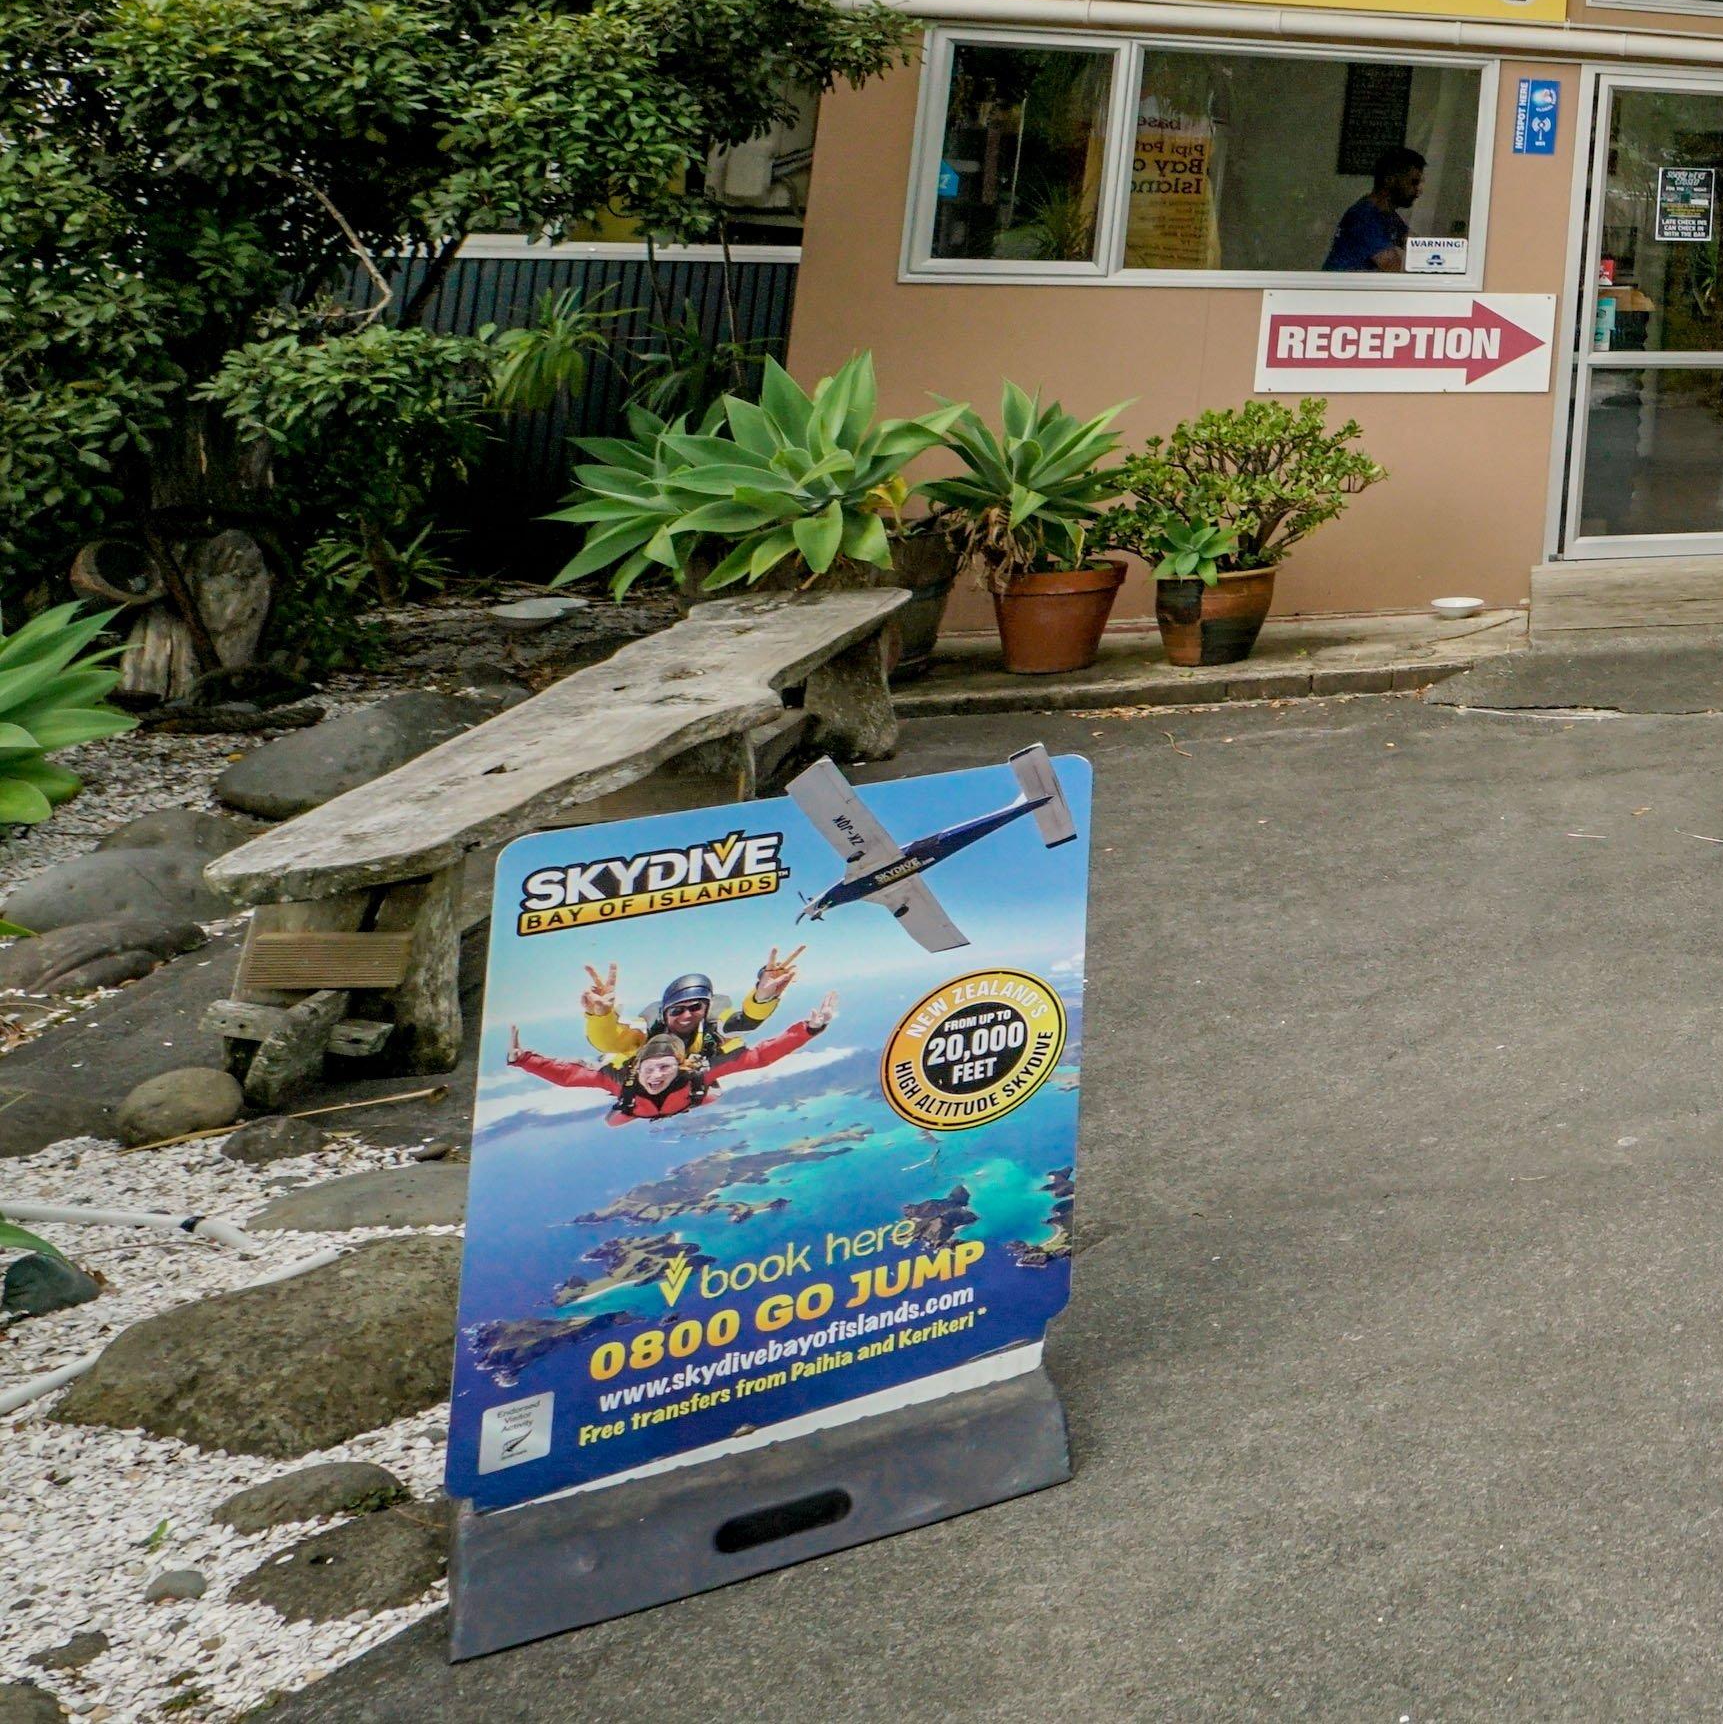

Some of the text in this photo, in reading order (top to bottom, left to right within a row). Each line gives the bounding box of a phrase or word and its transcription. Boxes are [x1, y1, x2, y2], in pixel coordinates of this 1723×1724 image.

[1515, 82, 1528, 149] HOTSPOT HERE
[1410, 240, 1464, 248] WARNING!
[1276, 326, 1502, 361] RECEPTION
[524, 834, 779, 911] SKYDIVE
[527, 875, 773, 930] BAY OF ISLANDS
[906, 979, 1048, 1038] NEW ZEALAND'S
[944, 1009, 1012, 1032] FROM UP TO
[927, 1021, 1025, 1066] 20,000
[952, 1057, 998, 1085] FEET
[895, 1031, 1053, 1117] HIGH ALTITUDE SKYDIVE
[701, 1219, 916, 1299] book here
[589, 1241, 985, 1381] 0800 GO JUMP
[600, 1285, 974, 1413] www.skydivebayofislands.com
[578, 1311, 974, 1447] Free transfers from Paihia and Kerikeri
[497, 1400, 541, 1418] Endorsed
